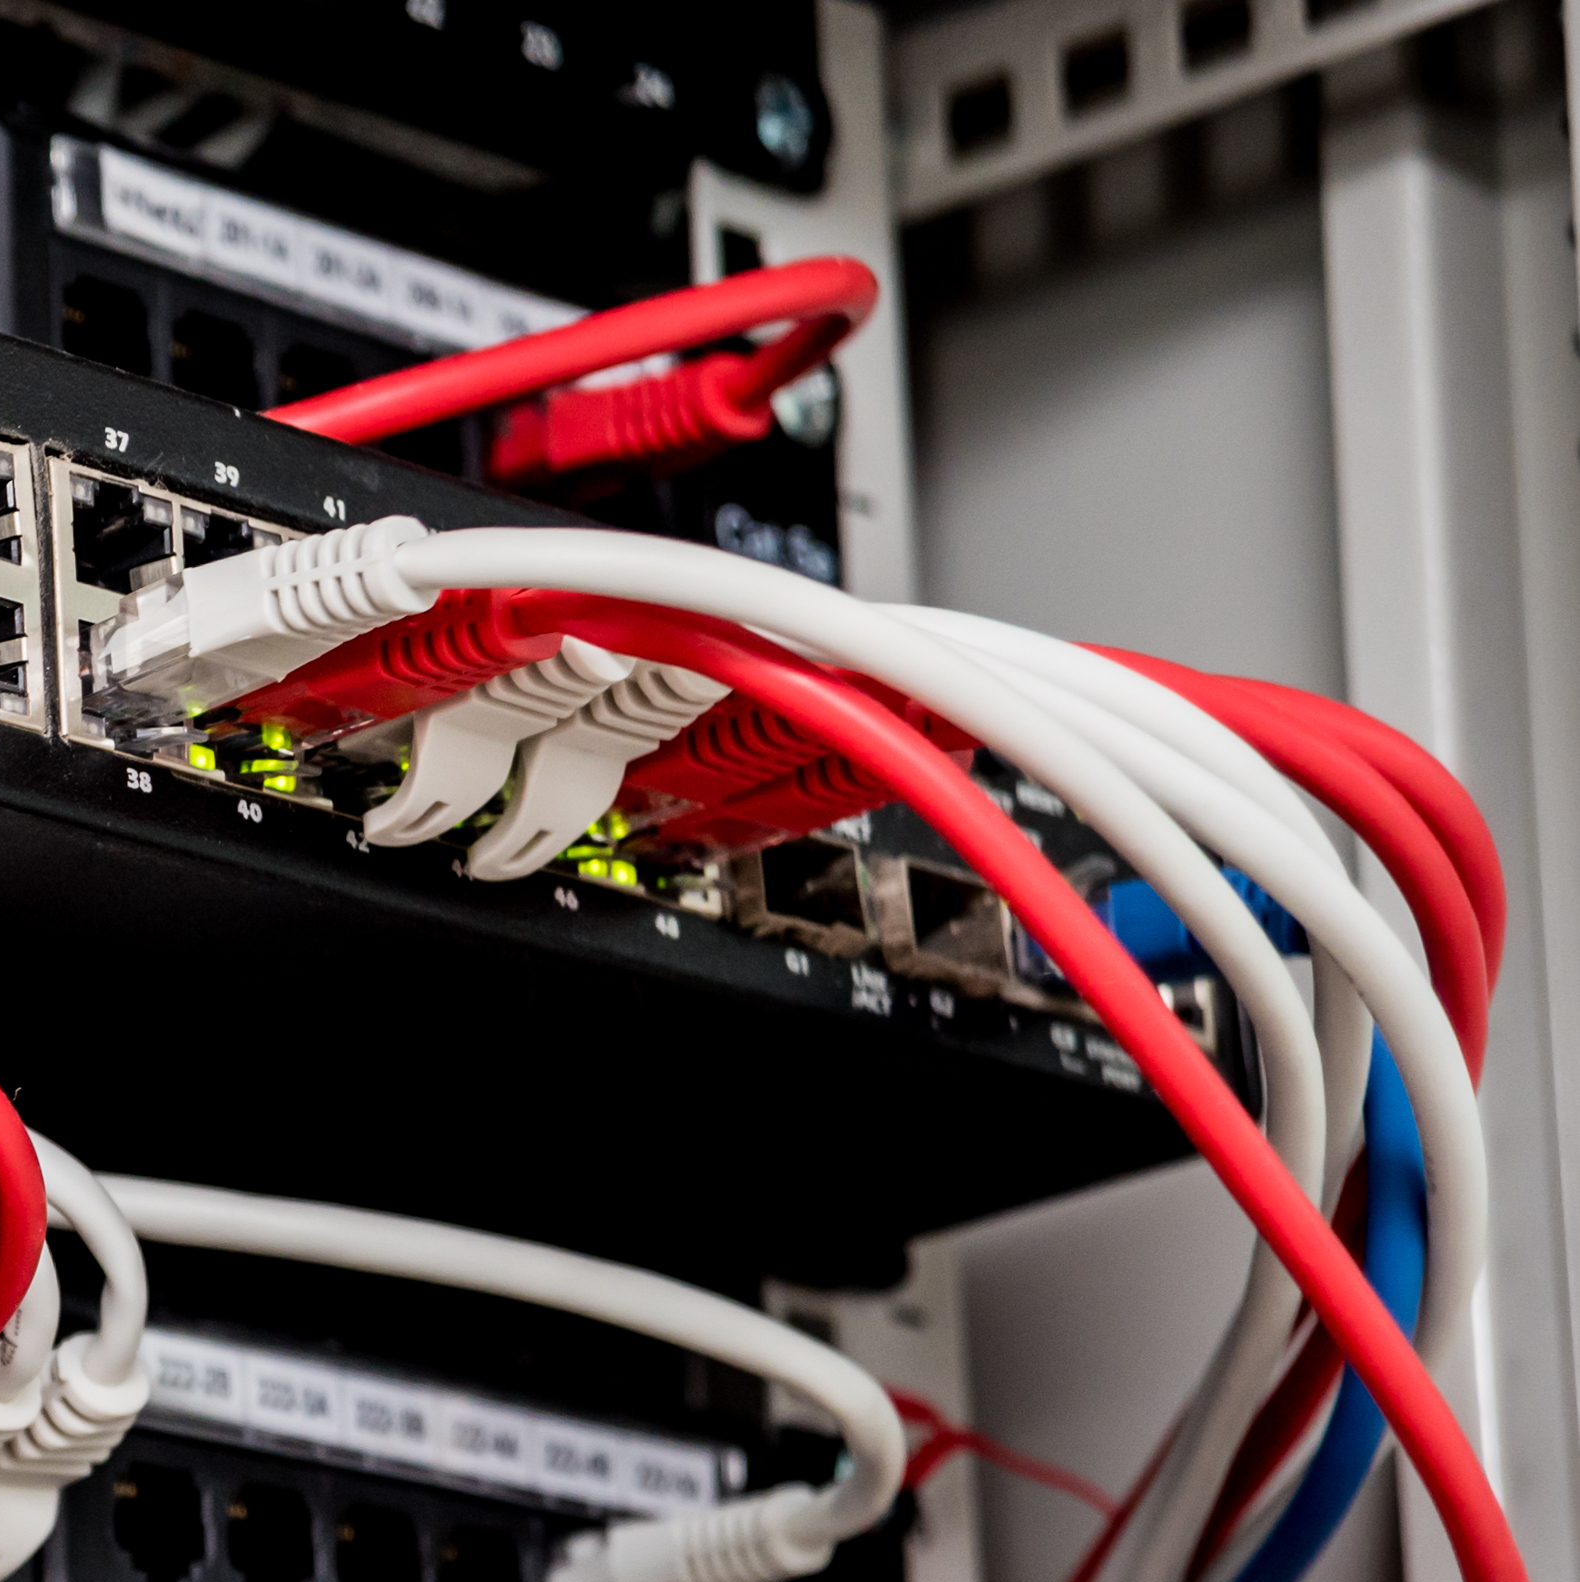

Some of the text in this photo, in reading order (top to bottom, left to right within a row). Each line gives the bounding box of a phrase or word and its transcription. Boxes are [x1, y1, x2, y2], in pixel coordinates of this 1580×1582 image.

[104, 426, 130, 453] 37
[214, 461, 240, 488] 39
[322, 495, 346, 522] 41
[126, 767, 153, 794] 38
[237, 798, 263, 824] 40
[345, 828, 371, 854] 42
[554, 886, 579, 911] 46
[654, 913, 680, 940] 48
